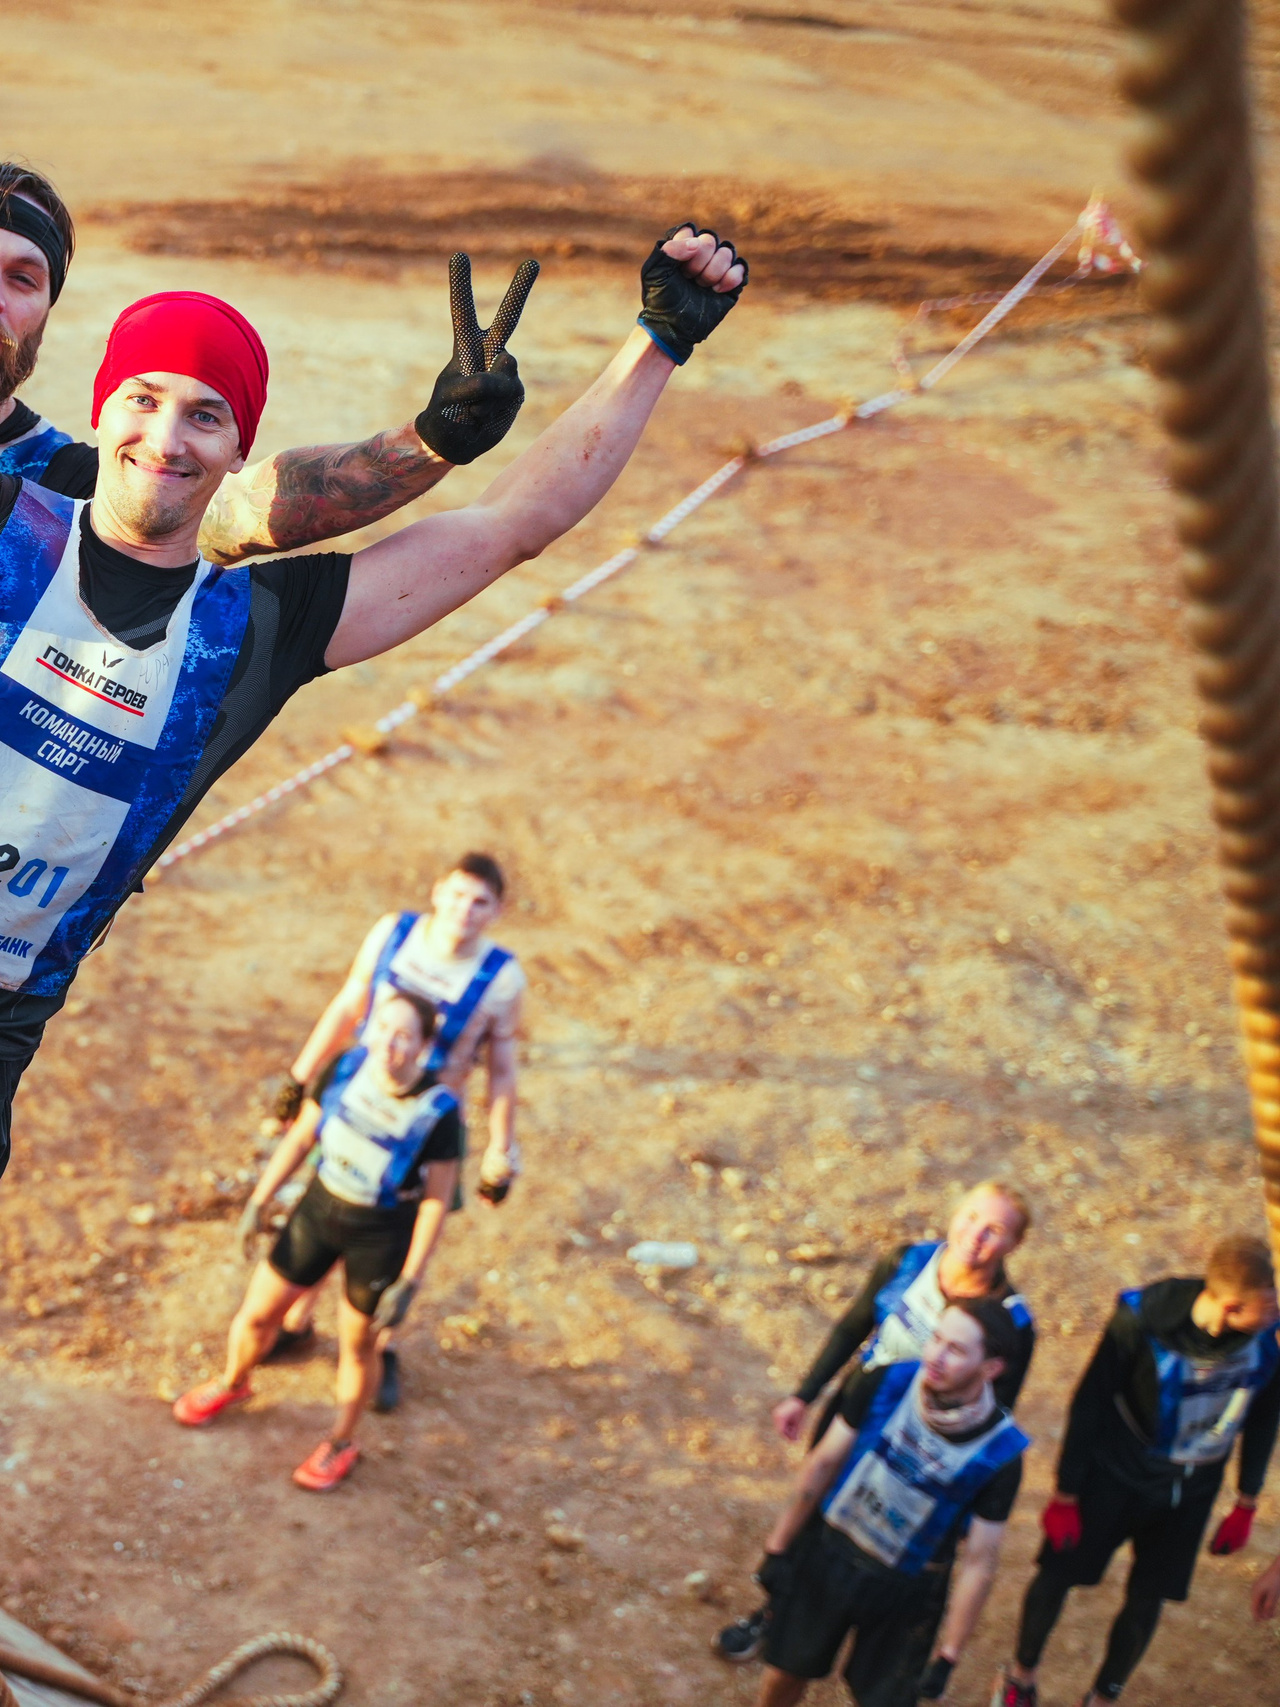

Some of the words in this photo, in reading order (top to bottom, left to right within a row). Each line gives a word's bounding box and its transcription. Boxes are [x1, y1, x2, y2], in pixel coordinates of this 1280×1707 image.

[43, 645, 95, 686] ГОНКА
[94, 675, 148, 709] ГЕРОЕВ
[19, 699, 124, 764] КОМАНДНЫЙ
[37, 740, 90, 775] СТАРТ
